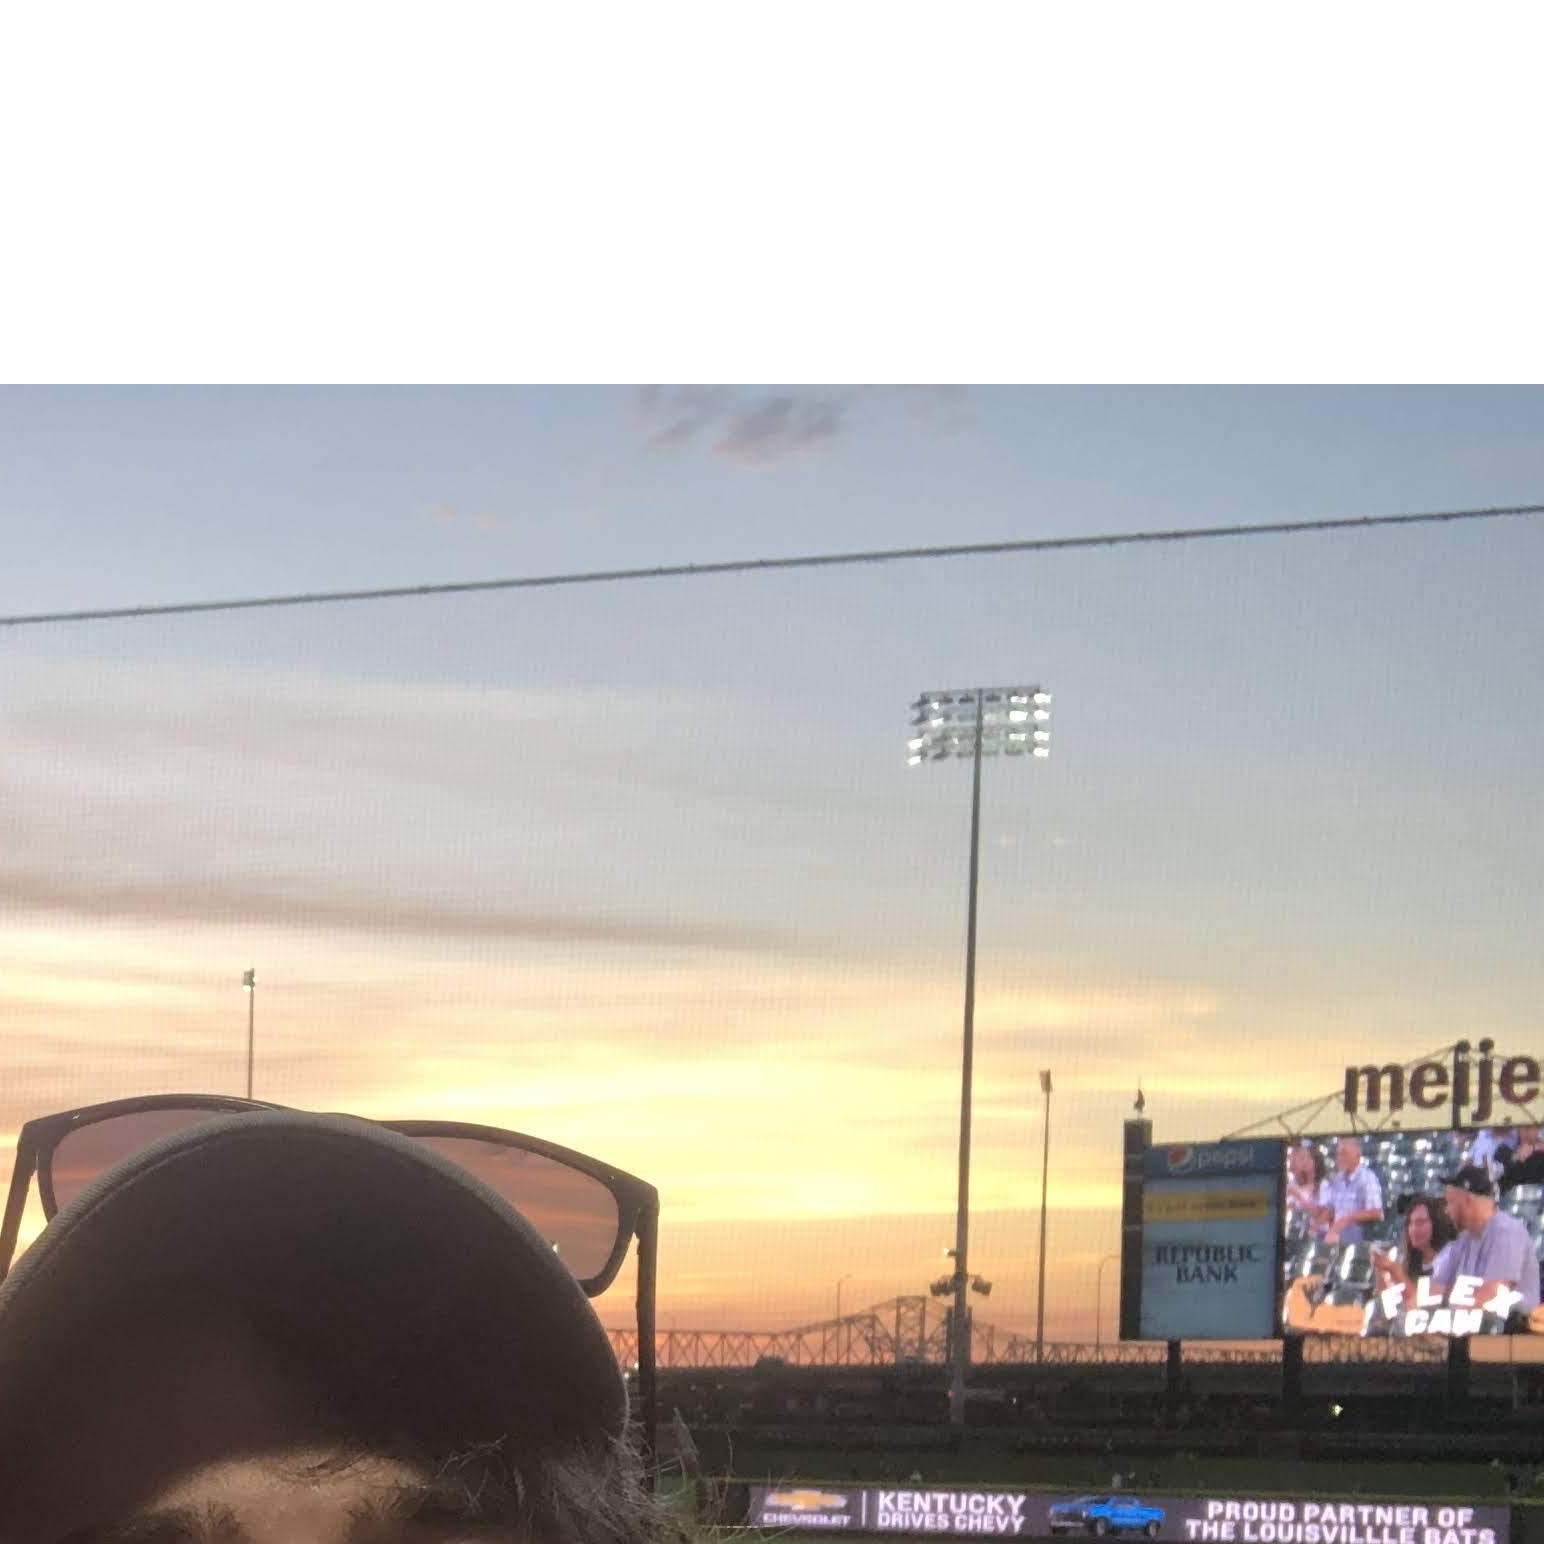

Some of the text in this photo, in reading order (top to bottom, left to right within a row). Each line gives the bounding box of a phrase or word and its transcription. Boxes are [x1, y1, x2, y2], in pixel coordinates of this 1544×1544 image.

[1344, 1037, 1541, 1121] meije
[1154, 1243, 1261, 1264] REPUBLIC
[1175, 1264, 1239, 1284] BANK
[1381, 1274, 1524, 1320] FLEX
[1404, 1308, 1484, 1336] CAM
[877, 1491, 1027, 1516] KENTUCKY
[1207, 1500, 1475, 1528] PROUD PARTNER OF
[762, 1513, 852, 1527] CHEVROLET
[877, 1512, 1026, 1532] DRIVES CHEVY
[1185, 1518, 1237, 1541] THE
